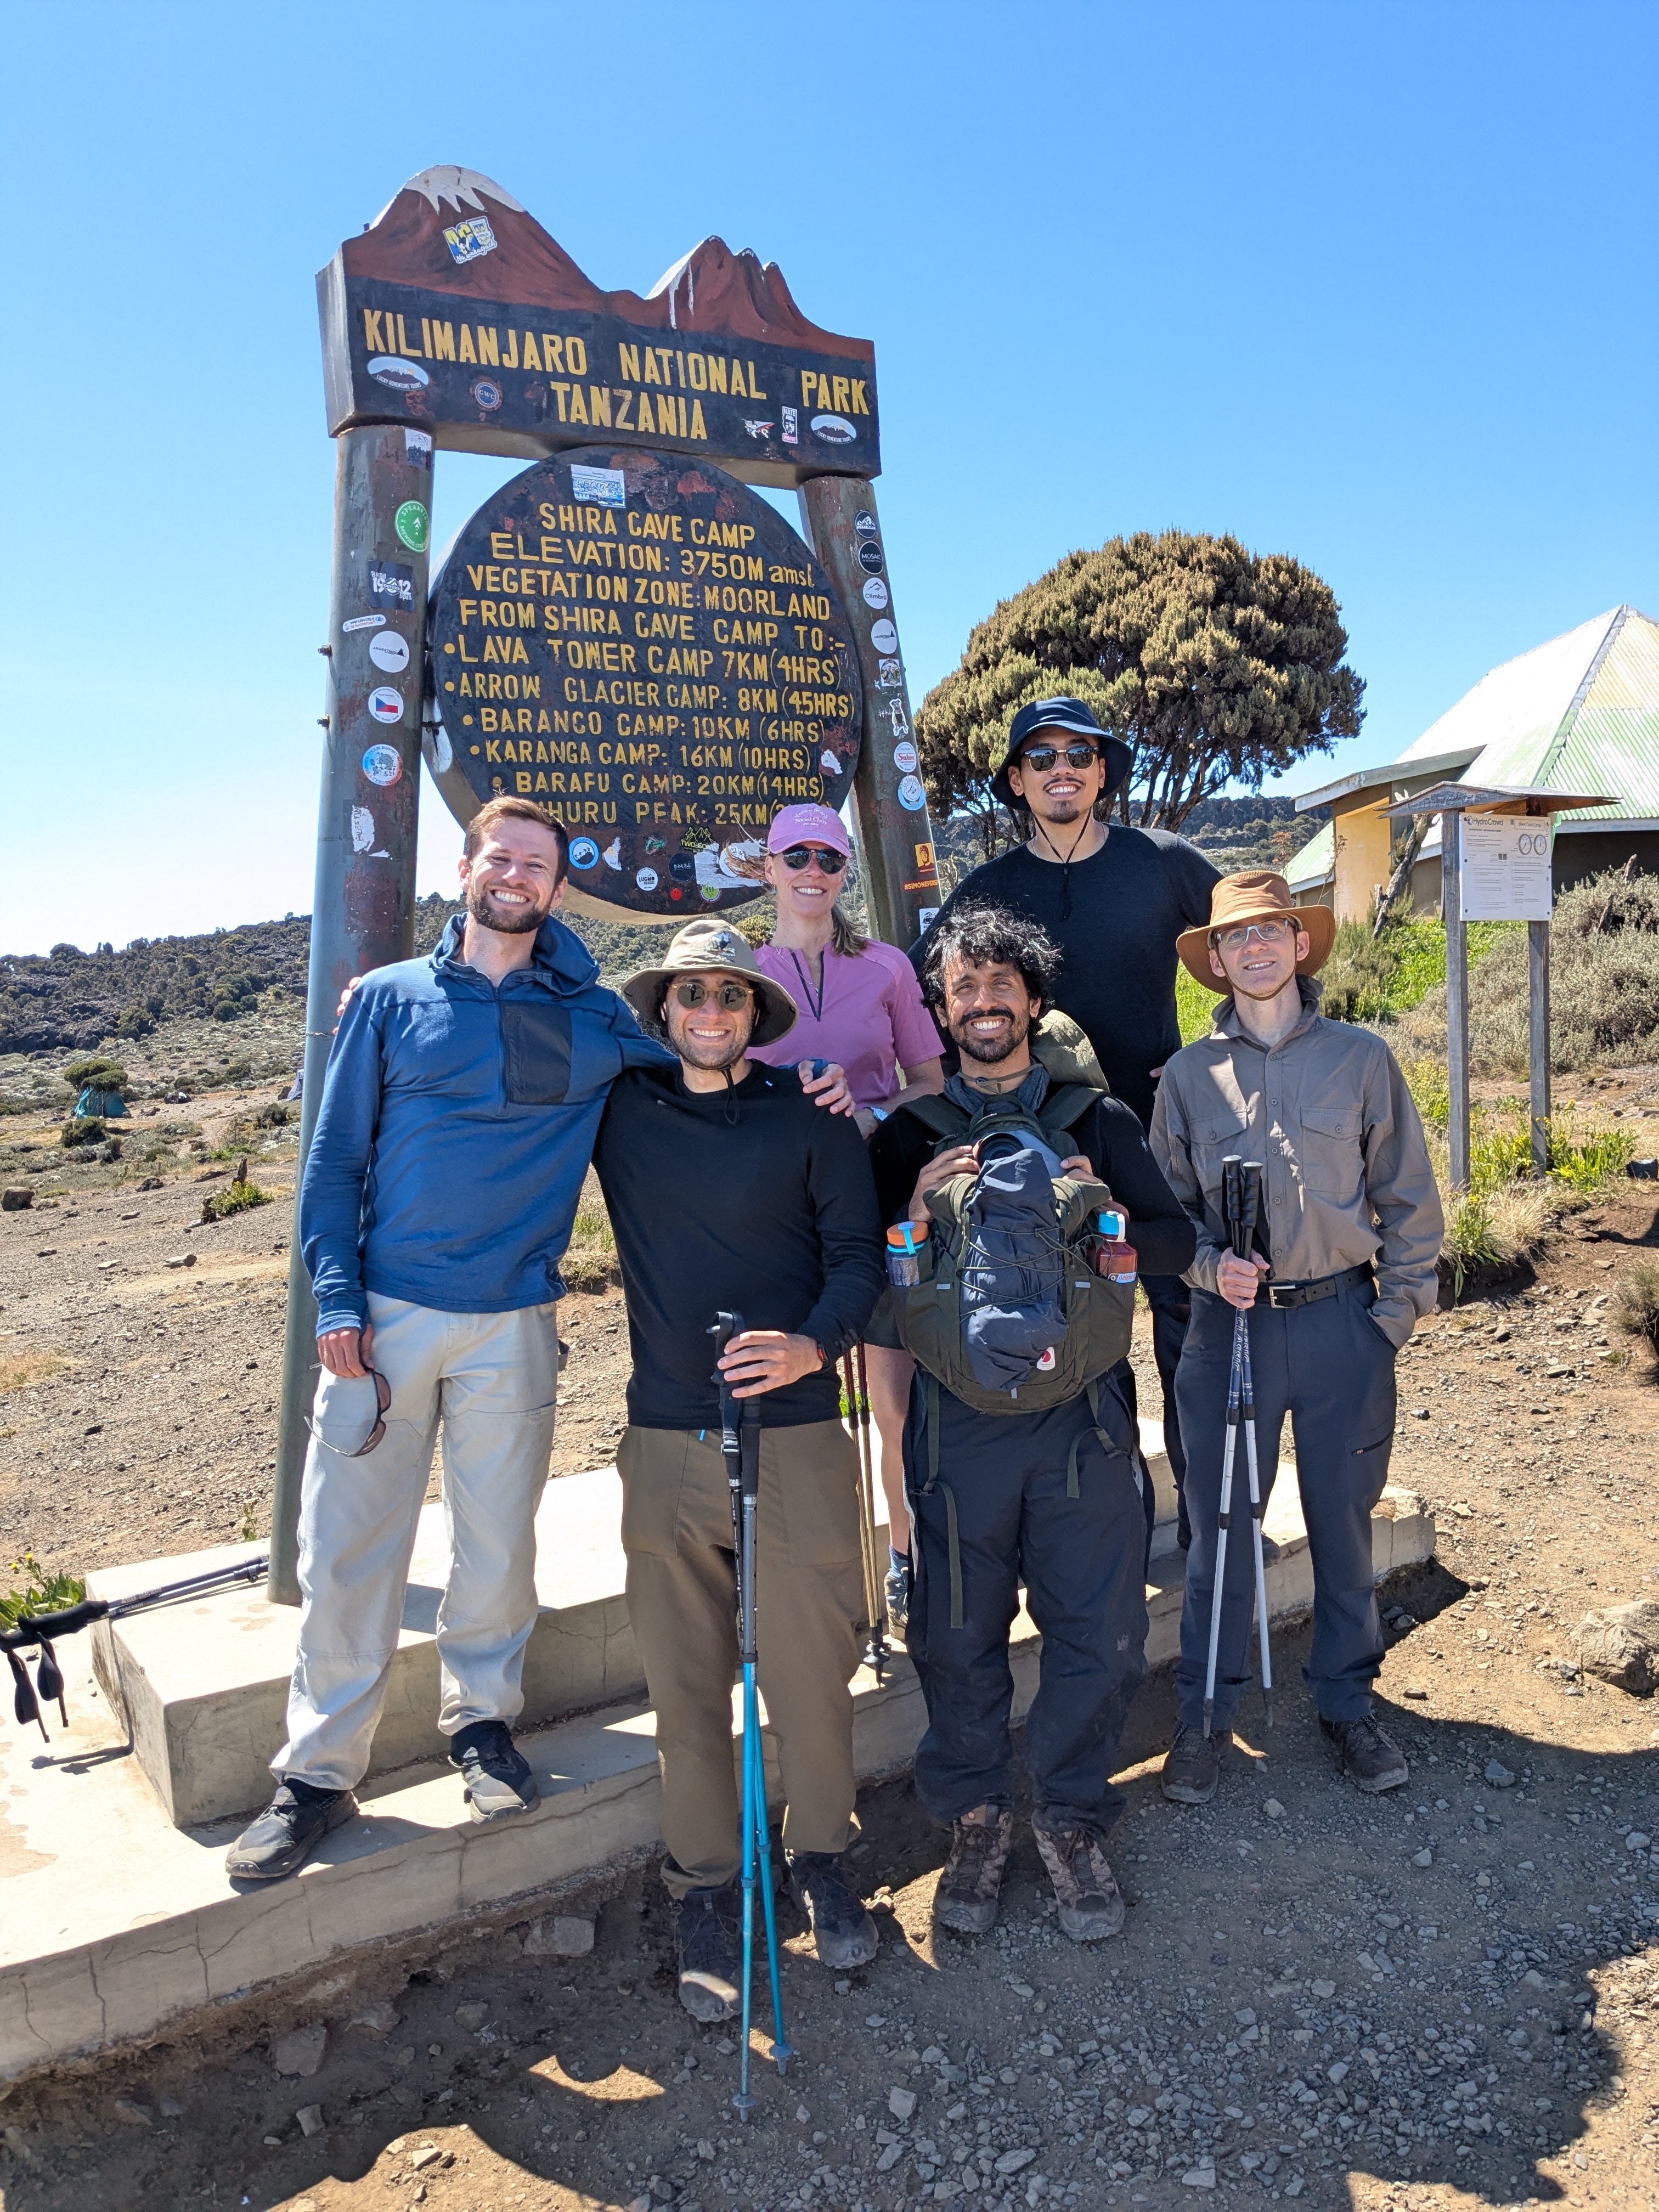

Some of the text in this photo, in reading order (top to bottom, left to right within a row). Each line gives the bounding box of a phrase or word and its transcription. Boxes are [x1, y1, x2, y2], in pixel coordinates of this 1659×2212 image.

[365, 309, 870, 415] KILIMANJARO NATIONAL PARK
[376, 374, 388, 384] LUCKY
[388, 380, 410, 390] ADVENTURE
[479, 390, 496, 400] GWC
[551, 382, 708, 440] TANZANIA
[783, 408, 796, 416] NATE
[817, 430, 827, 439] LUCKY
[539, 503, 755, 549] SHIRA CAVE CAMP
[490, 533, 816, 588] ELEVATION: 3750M amsl
[467, 565, 628, 603] VEGETATION
[460, 599, 535, 629] FROM
[544, 605, 621, 635] SHIRA
[635, 612, 695, 641] CAVE
[713, 618, 778, 647] CAMP
[459, 635, 529, 665] LAVA
[547, 639, 636, 673] TOWER
[647, 646, 713, 676] CAMP
[460, 673, 540, 699] ARROW
[564, 677, 660, 707] GLACIER
[667, 684, 727, 710] CAMP:
[481, 707, 825, 745] BARANCO CAMP: 10KM (6HRS)
[485, 740, 591, 765] KARANGA
[681, 745, 732, 768] 16KM
[516, 771, 610, 793] BARAFU
[623, 773, 691, 794] CAMP:
[541, 800, 616, 824] HURU
[636, 802, 706, 823] PEAK:
[1473, 817, 1504, 827] HydroCrowd
[1233, 1317, 1244, 1371] CLASSIC
[119, 1602, 144, 1613] TRAILMADE
